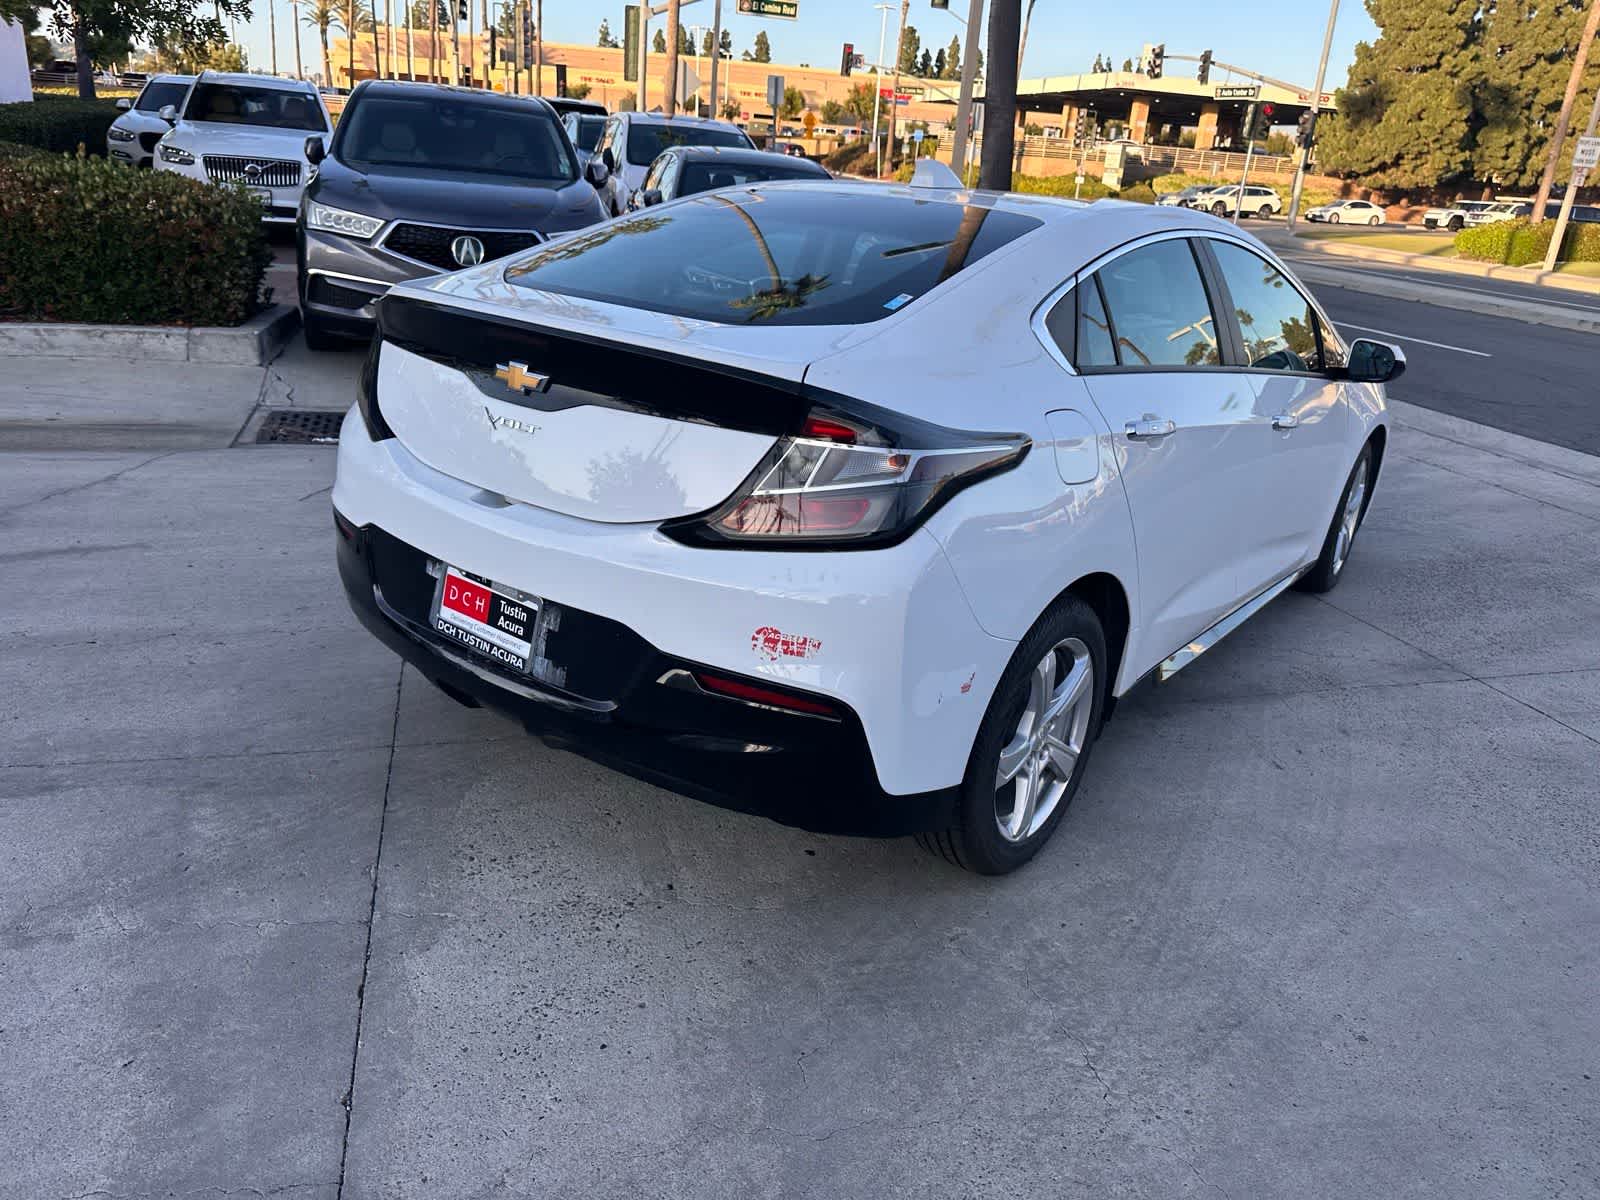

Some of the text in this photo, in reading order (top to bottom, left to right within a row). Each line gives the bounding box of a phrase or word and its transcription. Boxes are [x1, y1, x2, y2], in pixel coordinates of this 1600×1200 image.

[752, 1, 796, 15] El Camino Real
[500, 600, 527, 622] Tustin
[497, 616, 524, 636] Acura
[437, 620, 524, 670] DCH TUSTIN ACURA
